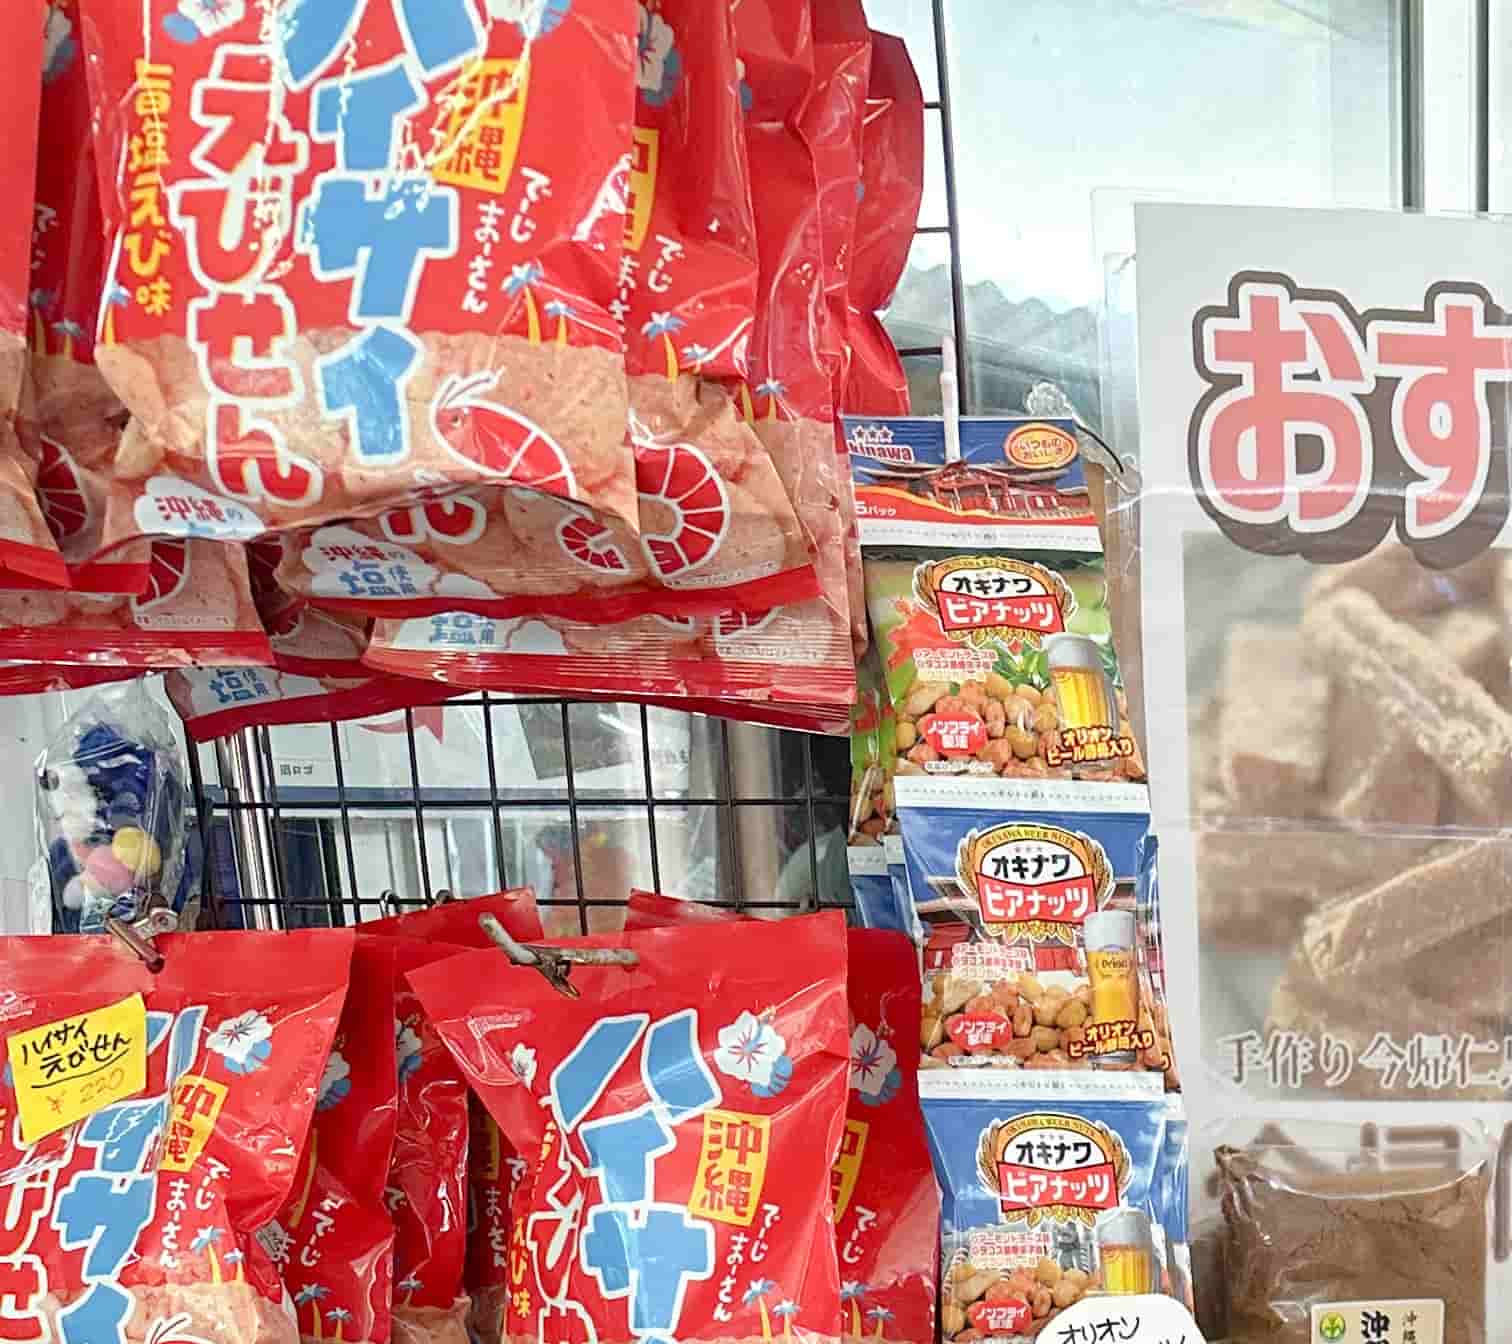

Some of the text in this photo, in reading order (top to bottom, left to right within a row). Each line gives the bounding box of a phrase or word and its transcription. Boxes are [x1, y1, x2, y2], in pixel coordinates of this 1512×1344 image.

[952, 576, 1032, 594] オキナワ
[992, 855, 1070, 880] オキナワ
[1016, 1139, 1092, 1164] オキナワ
